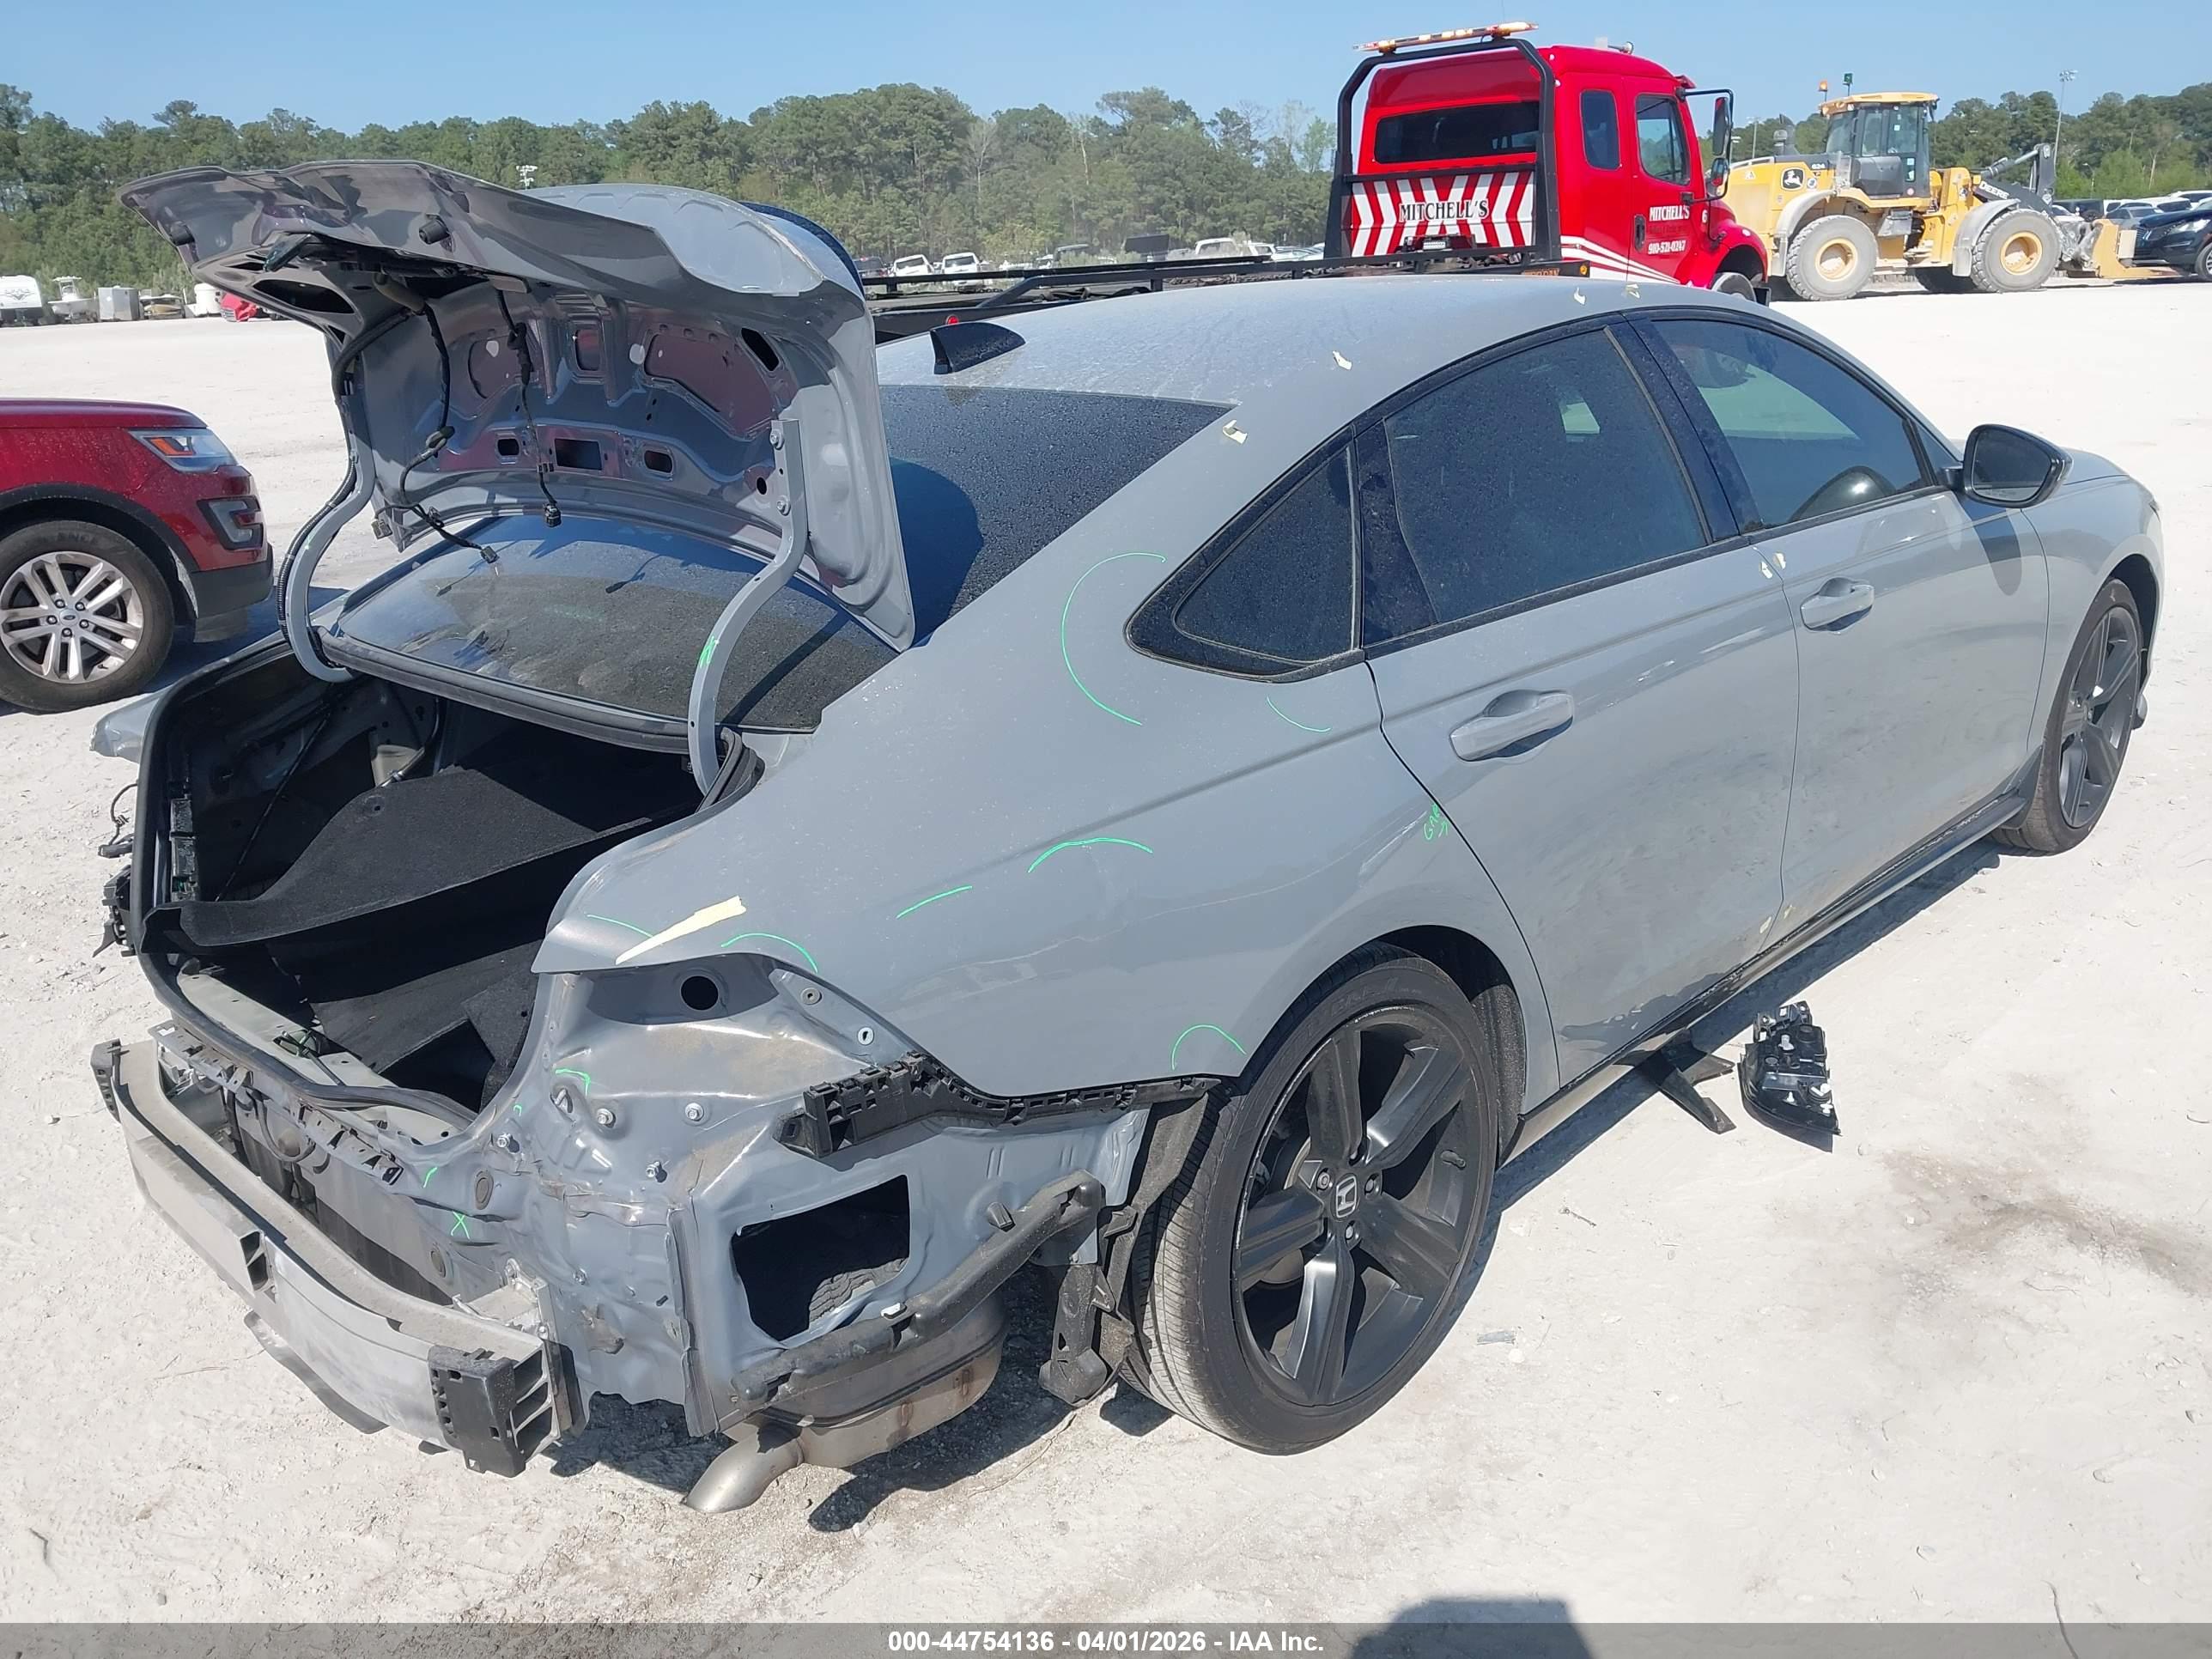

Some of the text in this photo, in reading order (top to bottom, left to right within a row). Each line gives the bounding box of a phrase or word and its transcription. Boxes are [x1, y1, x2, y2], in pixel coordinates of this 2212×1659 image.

[1978, 180, 2010, 200] DEERE
[1400, 200, 1488, 222] MITCHELL'S
[1649, 205, 1690, 222] MITCHELL'S
